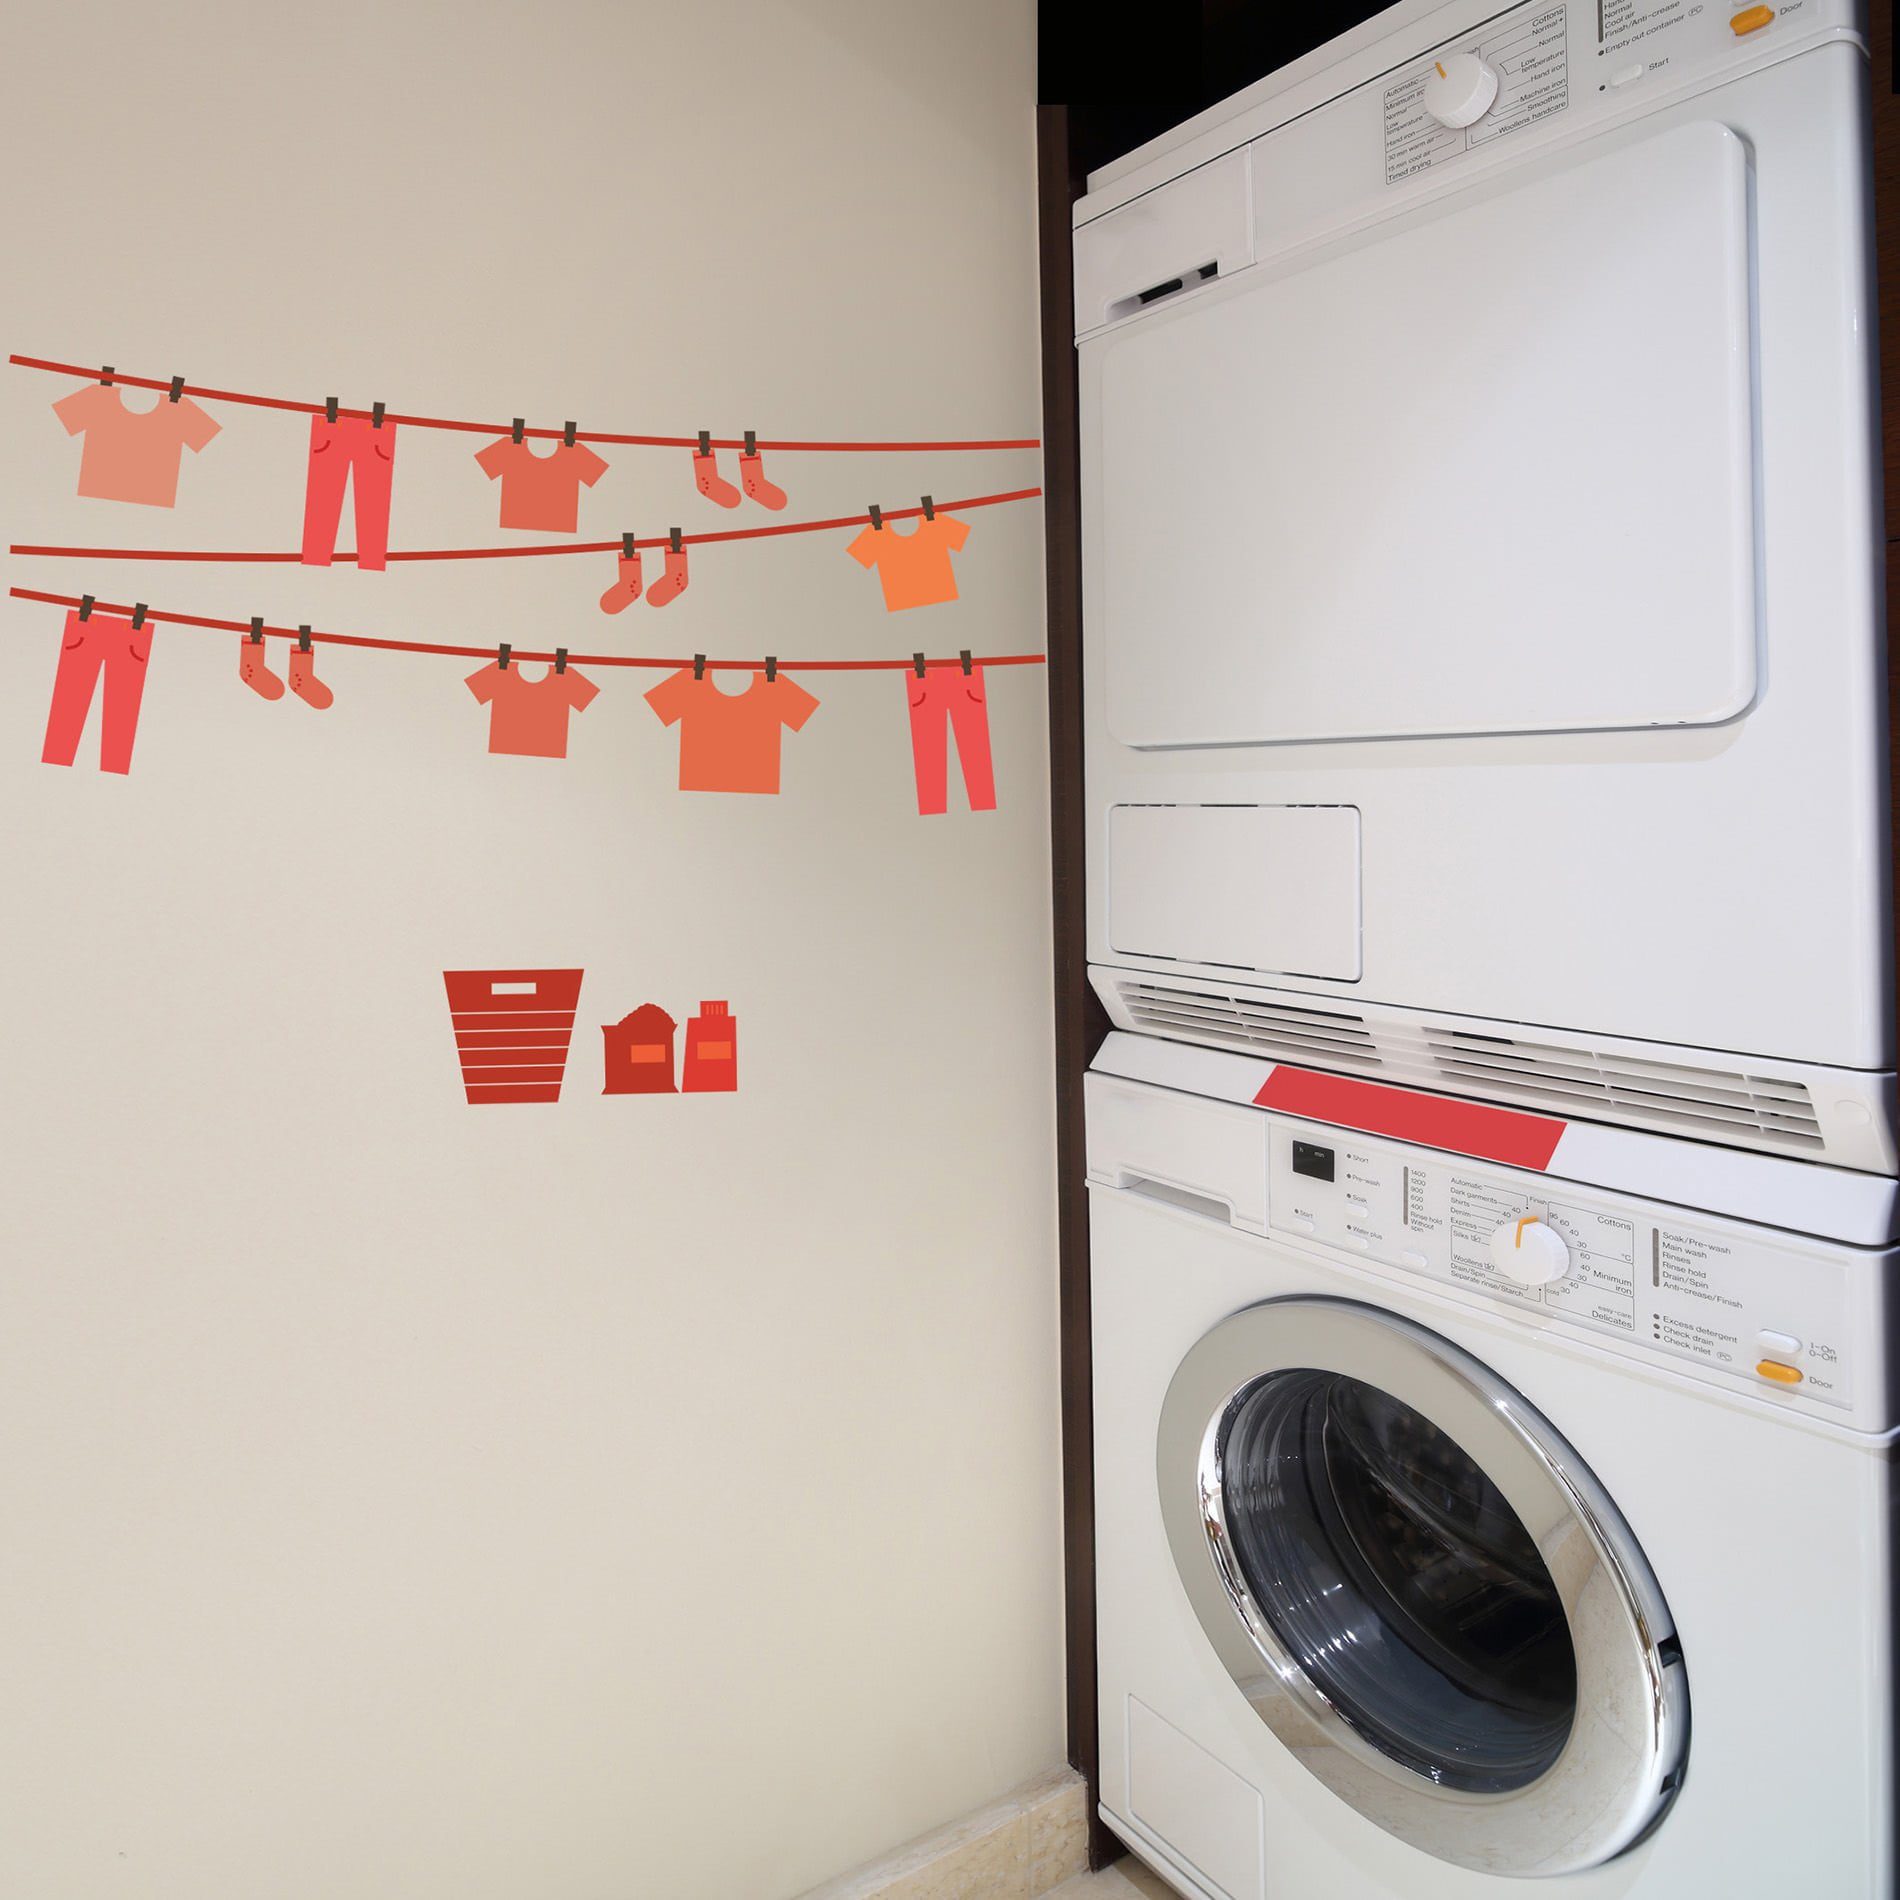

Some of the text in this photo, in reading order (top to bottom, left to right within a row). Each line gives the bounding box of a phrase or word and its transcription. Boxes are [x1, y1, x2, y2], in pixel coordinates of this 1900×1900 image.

[1604, 2, 1632, 19] Normal
[1779, 1, 1803, 16] Door
[1532, 7, 1564, 27] Cottons
[1604, 11, 1635, 29] Cool air
[1604, 1, 1681, 39] Finish/Anti-crease
[1532, 19, 1558, 36] Normal
[1605, 14, 1685, 54] Empty out container
[1539, 31, 1565, 47] Normal
[1521, 50, 1565, 73] temperature
[1521, 56, 1536, 68] Low
[1648, 57, 1670, 71] Start
[1530, 63, 1565, 82] Hand iron
[1386, 78, 1419, 98] Automatic
[1520, 79, 1566, 102] Machine iron
[1386, 93, 1415, 111] Minimum
[1527, 91, 1566, 112] Smoothing
[1386, 107, 1407, 121] Normal
[1498, 102, 1566, 134] Woollens handcare
[1386, 121, 1399, 130] Low
[1387, 114, 1423, 136] temperature
[1387, 131, 1416, 147] Hand iron
[1388, 153, 1396, 161] 30
[1396, 149, 1408, 157] min
[1409, 141, 1426, 153] warm
[1388, 150, 1431, 172] 15 min cool air
[1388, 159, 1432, 182] Timed drying
[1353, 1154, 1369, 1164] Short
[1352, 1174, 1380, 1187] Pre-wash
[1411, 1169, 1426, 1178] 1400
[1411, 1178, 1426, 1187] 1200
[1451, 1177, 1483, 1190] Automatic
[1450, 1187, 1466, 1197] Dark
[1466, 1192, 1498, 1205] garments
[1450, 1197, 1470, 1207] Shirts
[1529, 1196, 1548, 1205] Finish
[1300, 1209, 1313, 1218] Start
[1411, 1203, 1423, 1211] 400
[1450, 1207, 1471, 1217] Denim
[1411, 1211, 1443, 1225] Rinse hold
[1411, 1218, 1435, 1230] Without
[1450, 1217, 1477, 1230] Express
[1597, 1215, 1632, 1231] Cottons
[1352, 1225, 1383, 1240] Water plus
[1569, 1229, 1579, 1237] 40
[1577, 1240, 1587, 1248] 30
[1662, 1231, 1732, 1255] Soak/Pre-wash
[1662, 1242, 1708, 1259] Main wash
[1453, 1254, 1483, 1268] Woollens
[1580, 1252, 1590, 1260] 60
[1662, 1252, 1691, 1265] Rinses
[1450, 1262, 1486, 1279] Drain/Spin
[1662, 1261, 1707, 1279] Rinse hold
[1450, 1270, 1524, 1297] Separate rinse/Starch
[1569, 1281, 1579, 1289] 40
[1593, 1270, 1632, 1287] Minimum
[1662, 1271, 1709, 1289] Drain/Spin
[1560, 1286, 1571, 1294] 30
[1615, 1285, 1632, 1294] iron
[1663, 1281, 1743, 1309] Anti-crease/Finish
[1592, 1310, 1632, 1328] Delicates
[1663, 1316, 1738, 1343] Excess detergent
[1663, 1326, 1714, 1346] Check drain
[1663, 1336, 1711, 1355] Check inlet
[1809, 1376, 1833, 1389] Door
